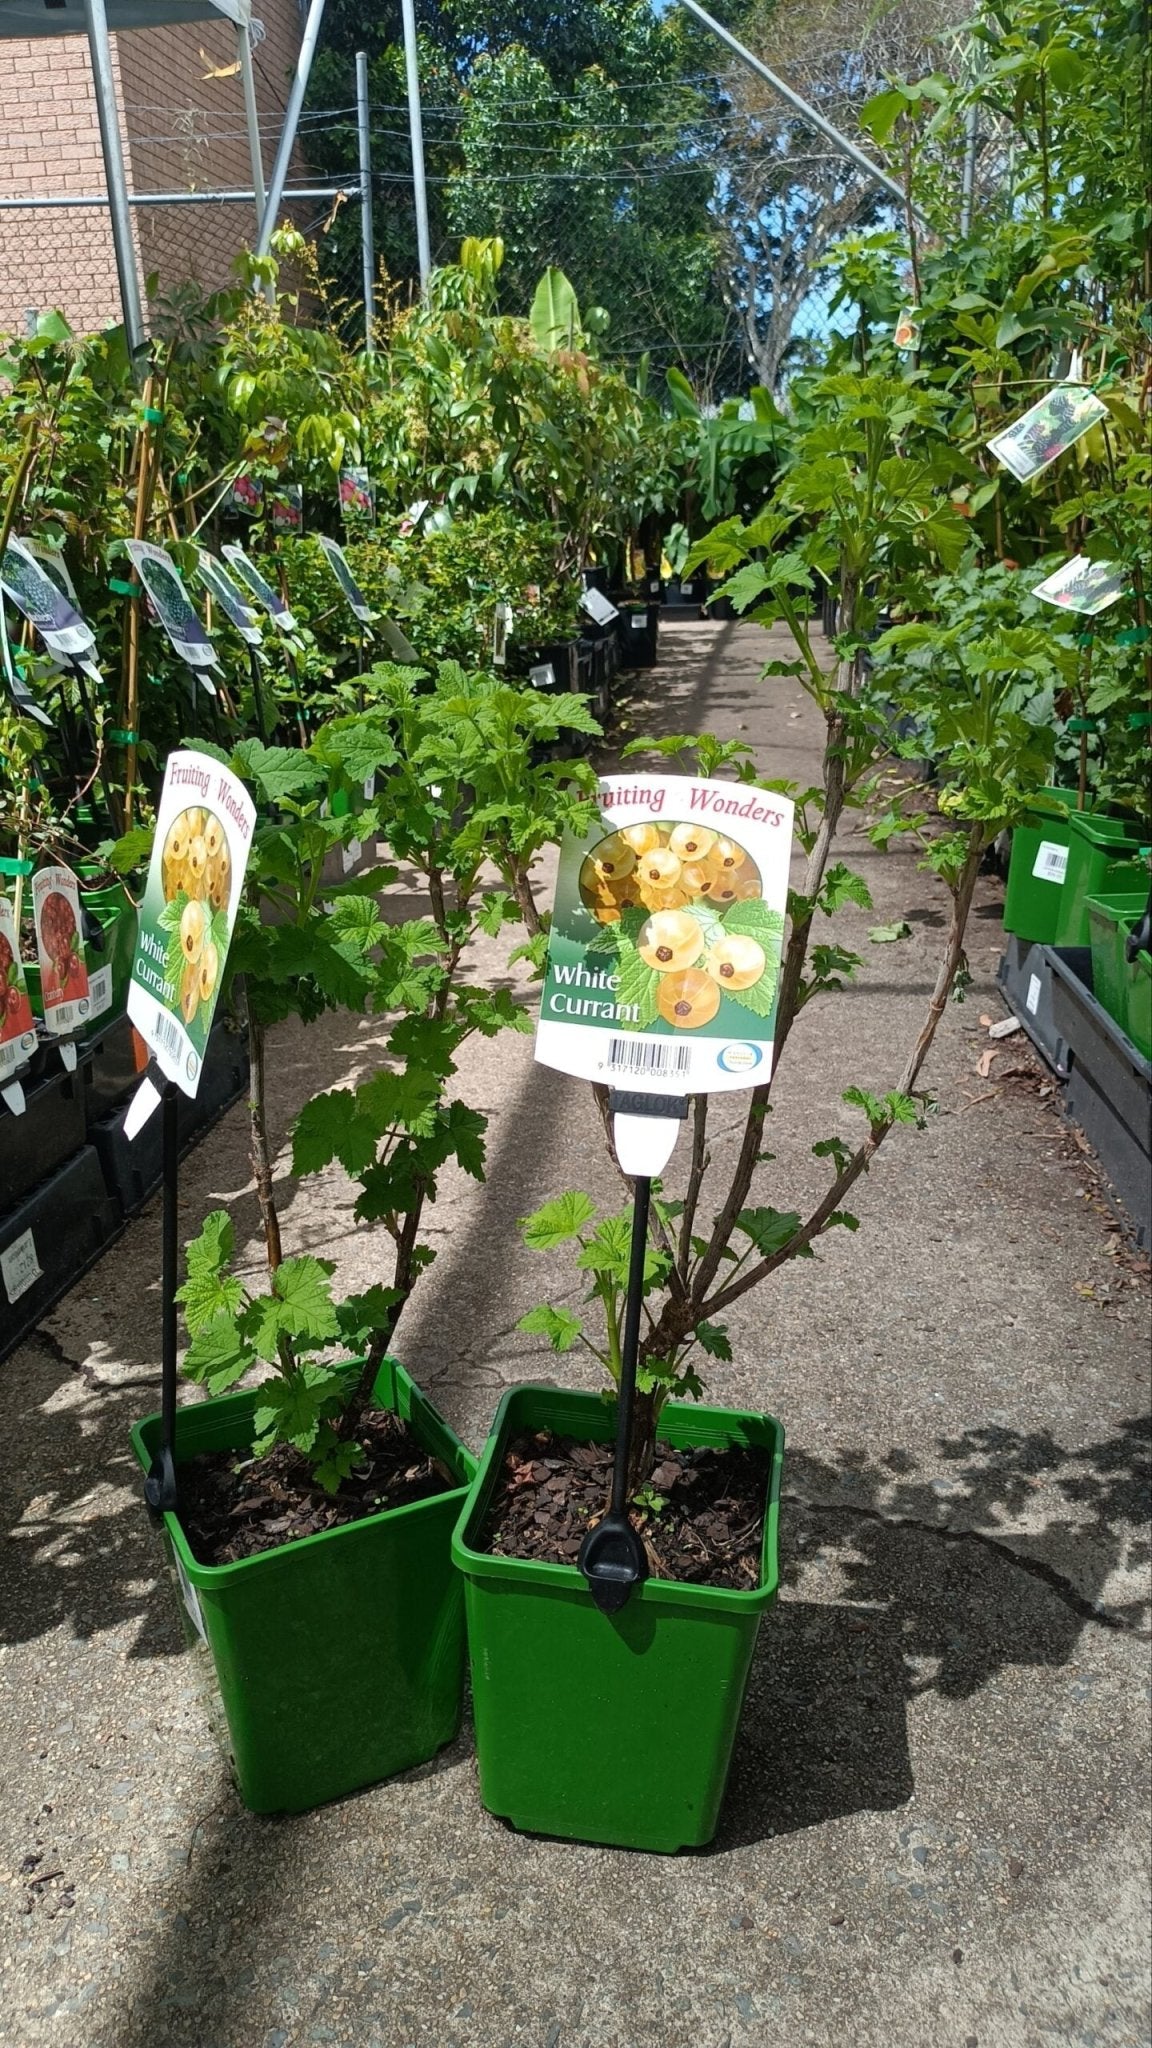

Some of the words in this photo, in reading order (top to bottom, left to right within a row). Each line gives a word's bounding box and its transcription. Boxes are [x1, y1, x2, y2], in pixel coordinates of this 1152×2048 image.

[170, 762, 210, 798] Fruiting
[217, 778, 250, 840] Wonders
[688, 787, 785, 827] Wonders
[140, 930, 169, 969] White
[136, 958, 177, 1002] Currant
[553, 962, 621, 992] White
[550, 993, 641, 1023] Currant
